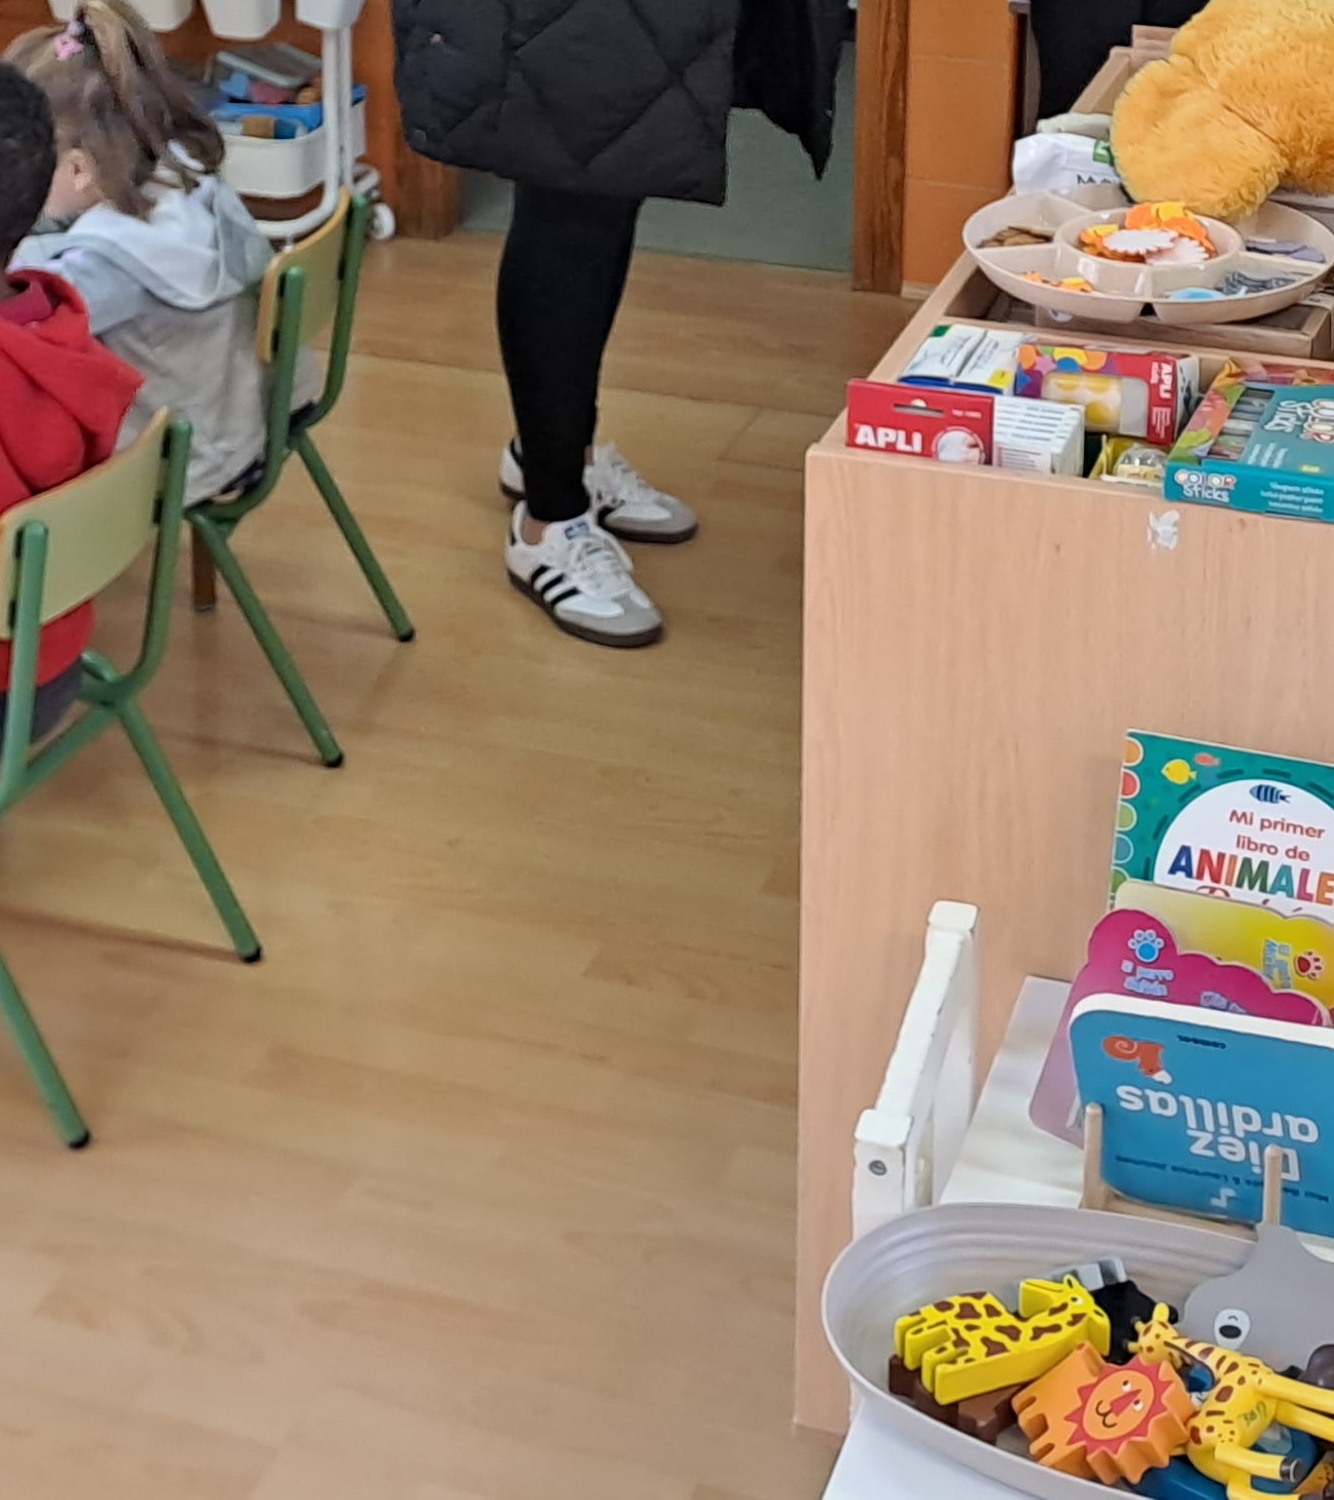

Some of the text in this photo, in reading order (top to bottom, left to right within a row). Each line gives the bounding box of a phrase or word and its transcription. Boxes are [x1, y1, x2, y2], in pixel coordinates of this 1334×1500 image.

[1159, 362, 1173, 399] APLI
[855, 424, 923, 453] APLI
[1174, 468, 1237, 489] COLOR
[1182, 483, 1230, 503] Sticks
[1228, 809, 1326, 839] Mi primer
[1236, 834, 1311, 862] libro de
[1115, 1084, 1319, 1144] ardillas
[1186, 1128, 1301, 1183] Diez
